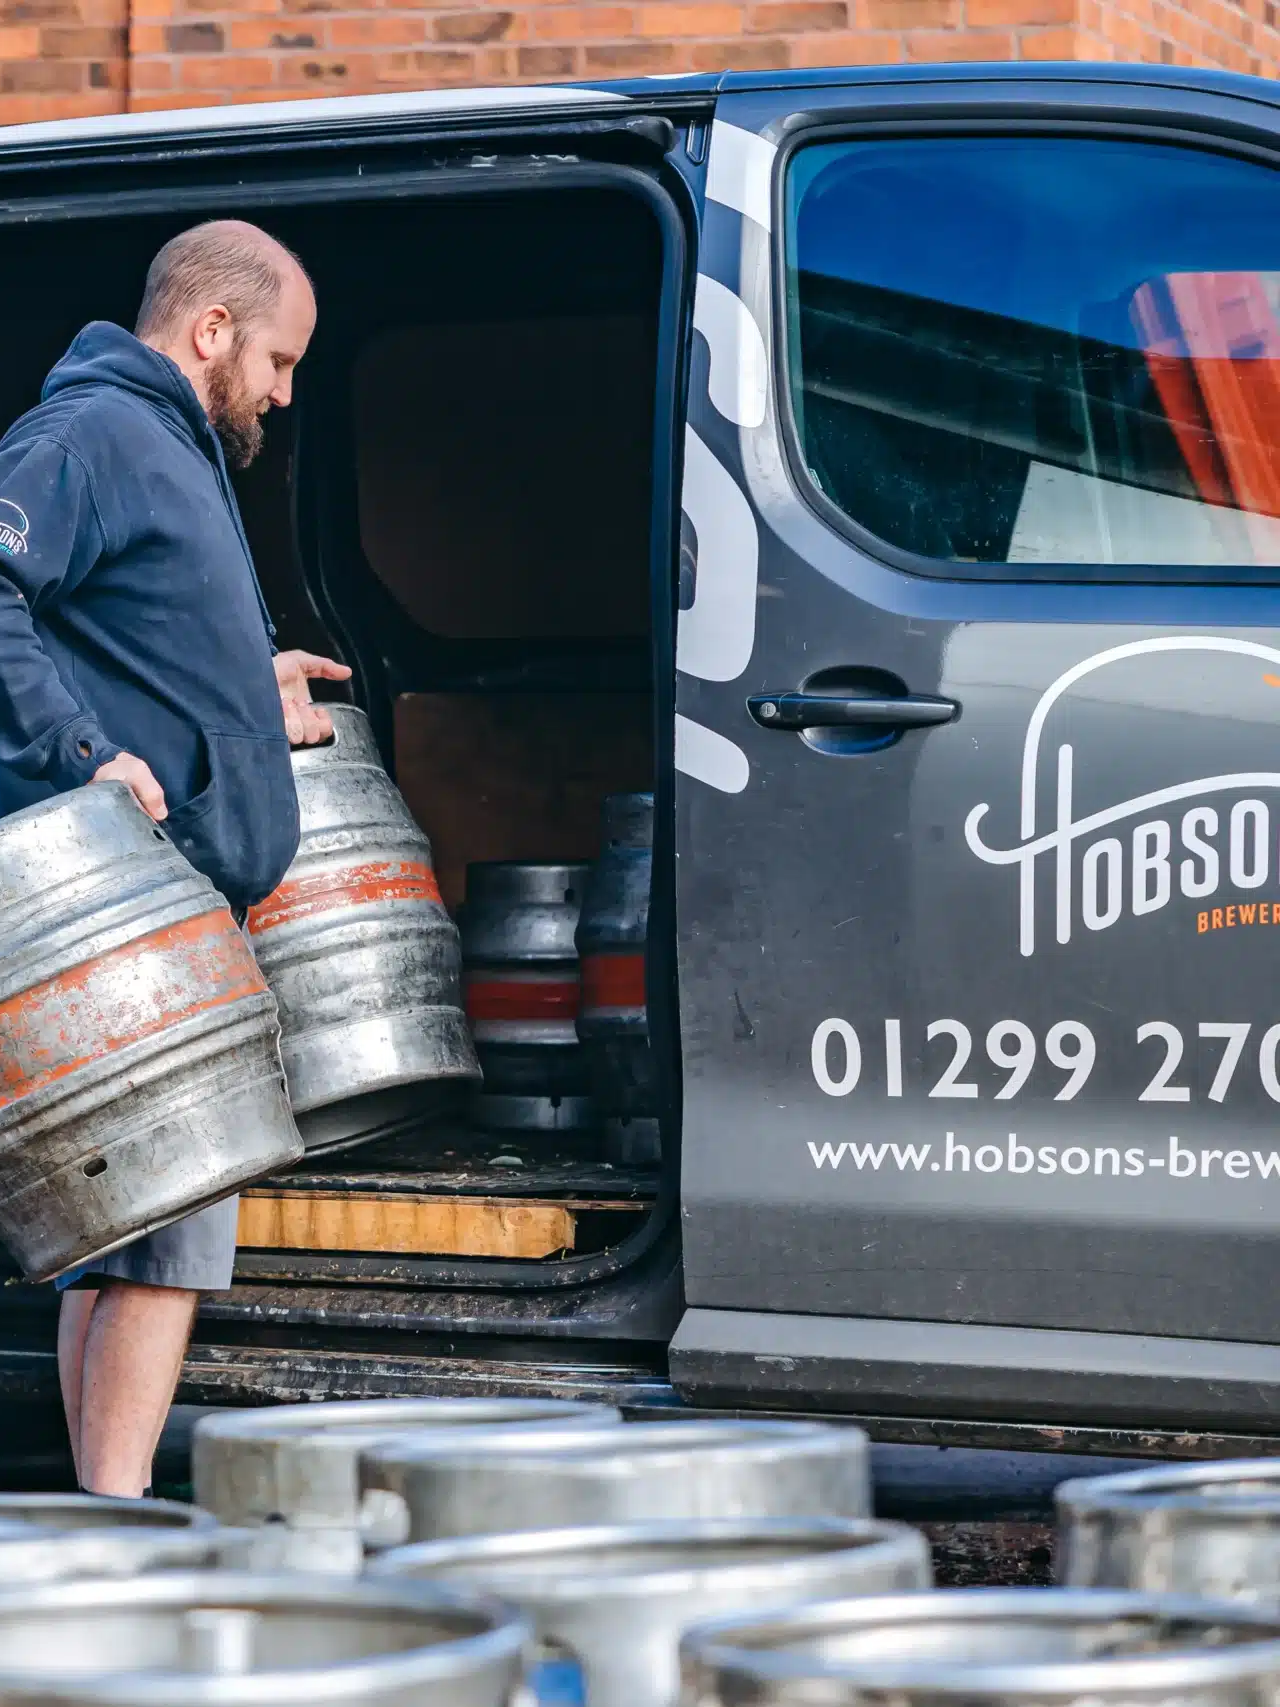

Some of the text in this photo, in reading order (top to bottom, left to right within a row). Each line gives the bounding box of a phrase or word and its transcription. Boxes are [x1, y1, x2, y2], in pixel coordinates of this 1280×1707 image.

[964, 743, 1280, 957] HOBSO
[1197, 903, 1280, 935] BREWER
[811, 1017, 1096, 1101] 01299
[806, 1131, 1280, 1180] www.hobsons-brew
